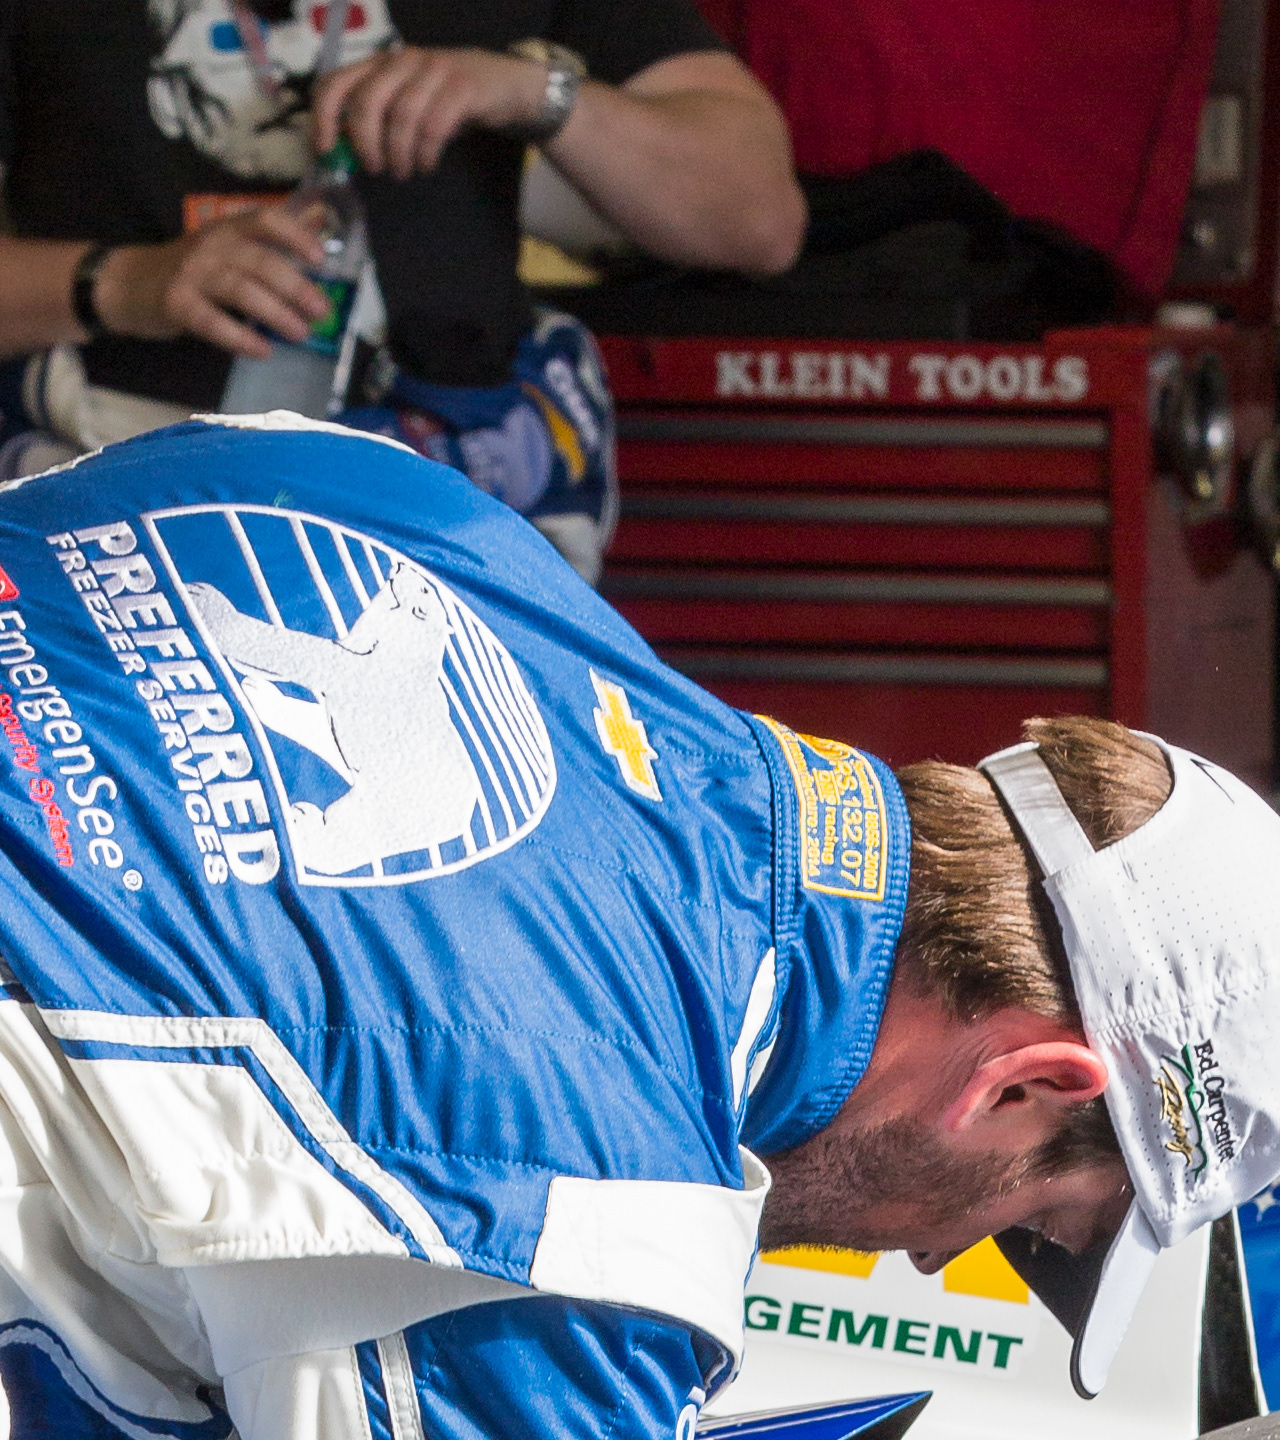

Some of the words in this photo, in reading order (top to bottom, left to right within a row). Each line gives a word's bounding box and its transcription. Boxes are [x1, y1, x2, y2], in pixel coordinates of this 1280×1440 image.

[715, 352, 890, 398] KLEIN
[909, 354, 1089, 401] TOOLS
[45, 531, 148, 677] FREEZER
[135, 679, 229, 886] SERVICES
[72, 519, 281, 886] PREFERRED
[29, 777, 75, 868] System
[820, 805, 839, 866] racing
[1193, 1038, 1219, 1075] Ed
[1203, 1076, 1237, 1164] Carpenter
